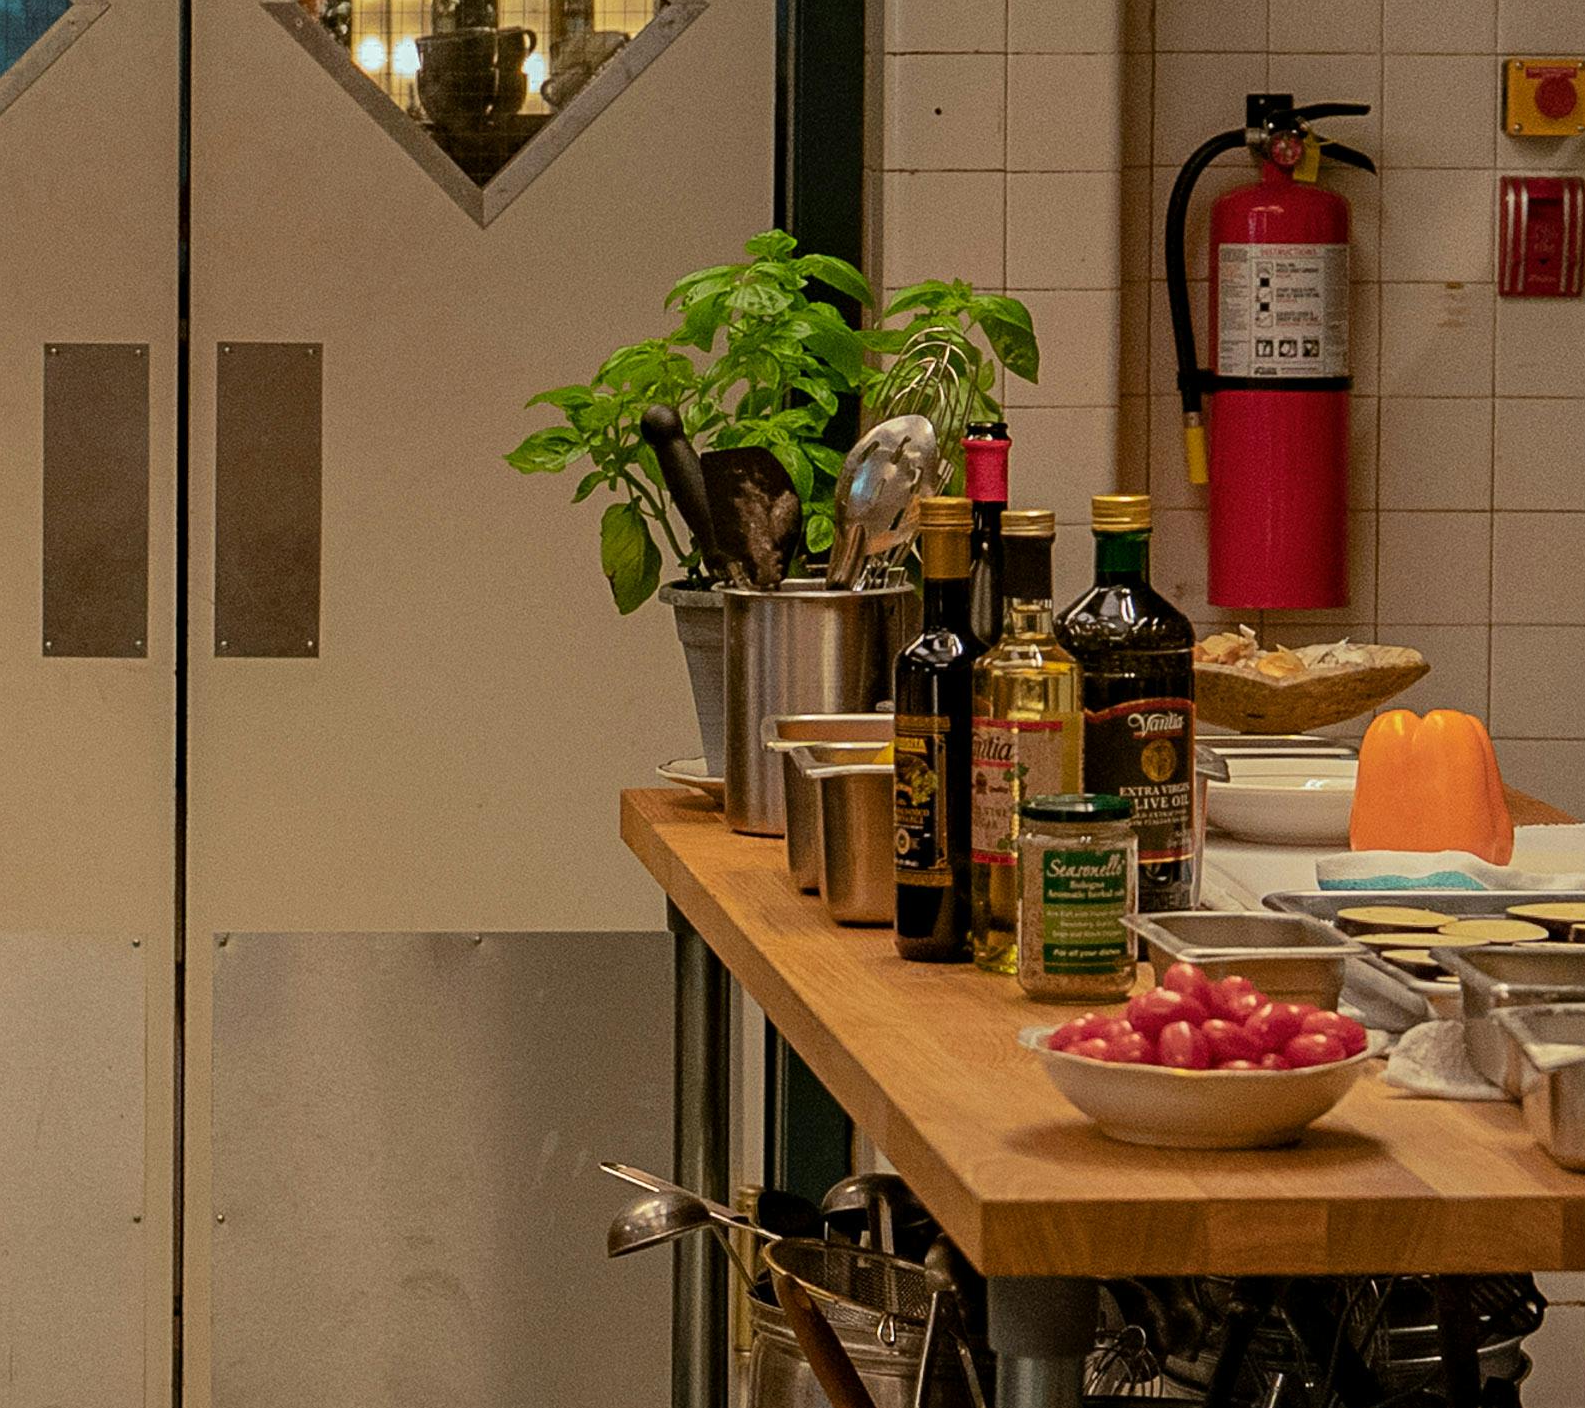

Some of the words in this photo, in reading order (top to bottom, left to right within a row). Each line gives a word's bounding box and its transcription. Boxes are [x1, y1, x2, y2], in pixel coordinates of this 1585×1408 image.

[973, 734, 1013, 761] ntia
[1119, 784, 1160, 797] EXTRA
[1134, 796, 1170, 810] LIVE
[1171, 793, 1189, 808] OIL
